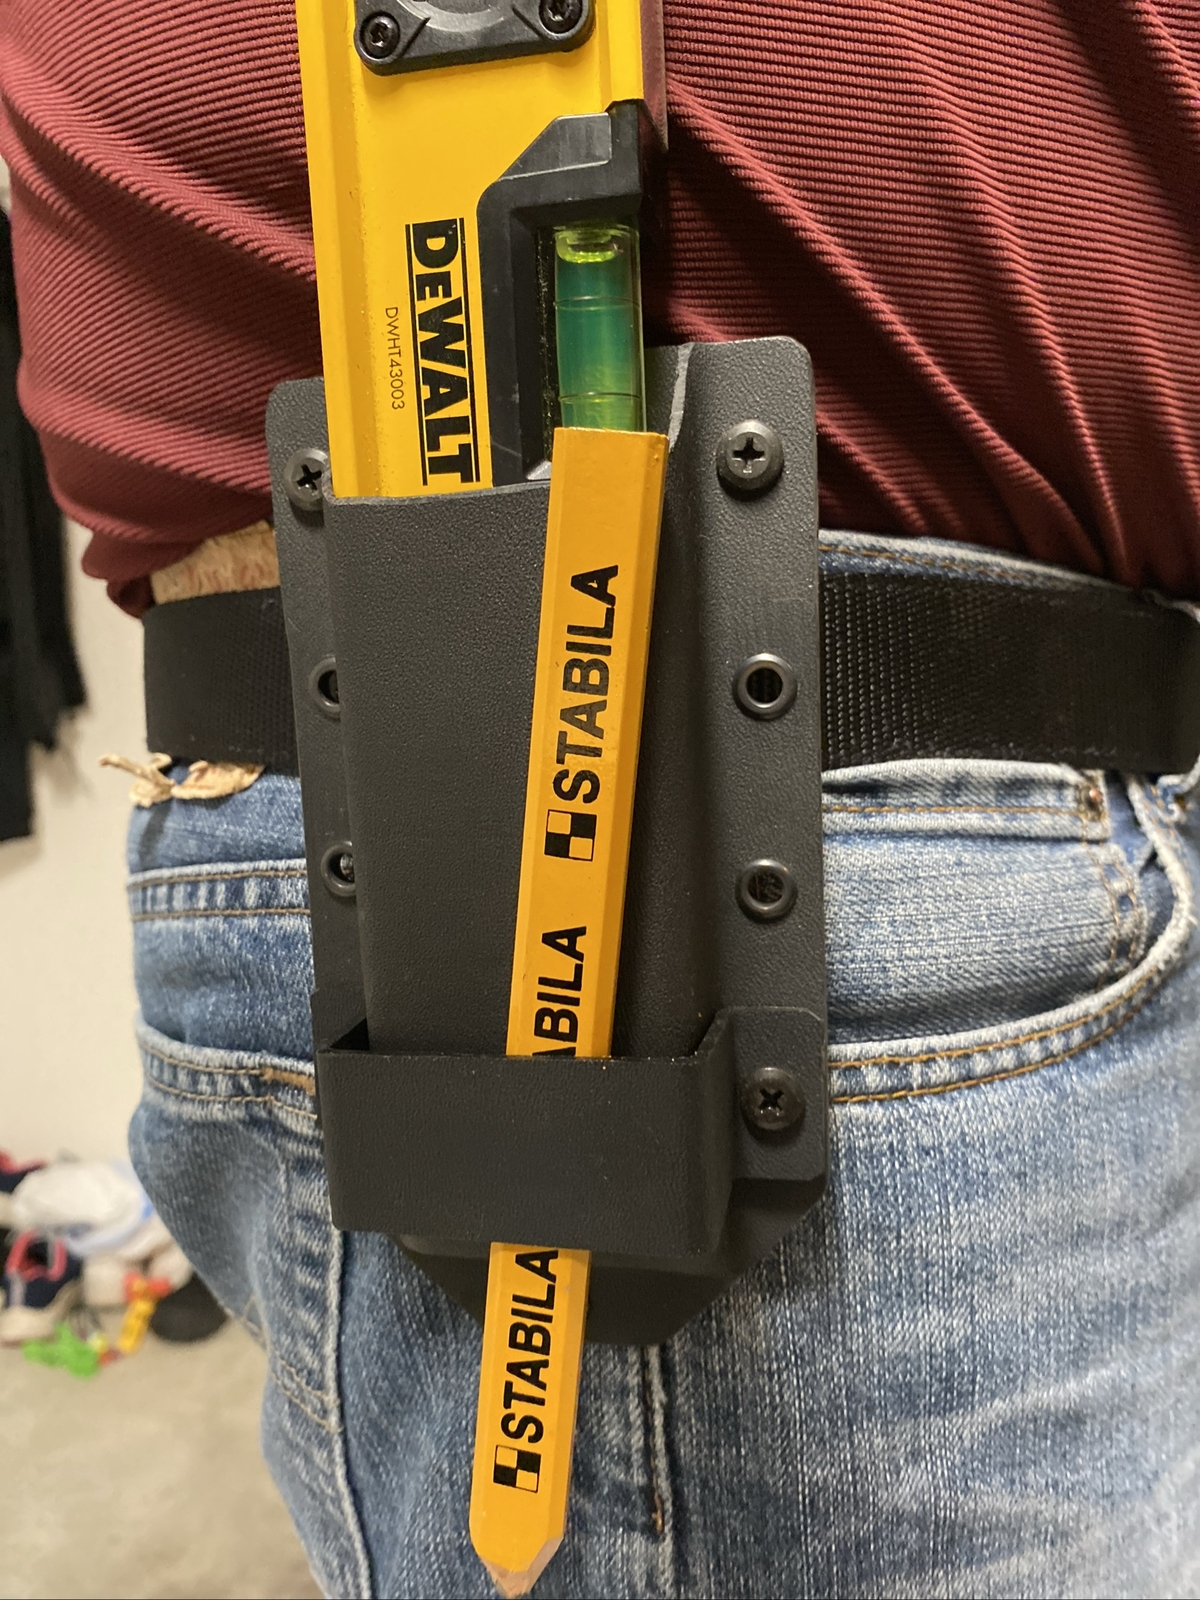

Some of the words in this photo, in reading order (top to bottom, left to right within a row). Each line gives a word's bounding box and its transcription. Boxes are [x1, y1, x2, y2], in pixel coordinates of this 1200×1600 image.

[385, 306, 405, 411] DWHT43003
[411, 218, 475, 484] DEWALT
[552, 564, 619, 804] STABILA
[532, 926, 587, 1056] BILA
[501, 1250, 559, 1444] STABILA
